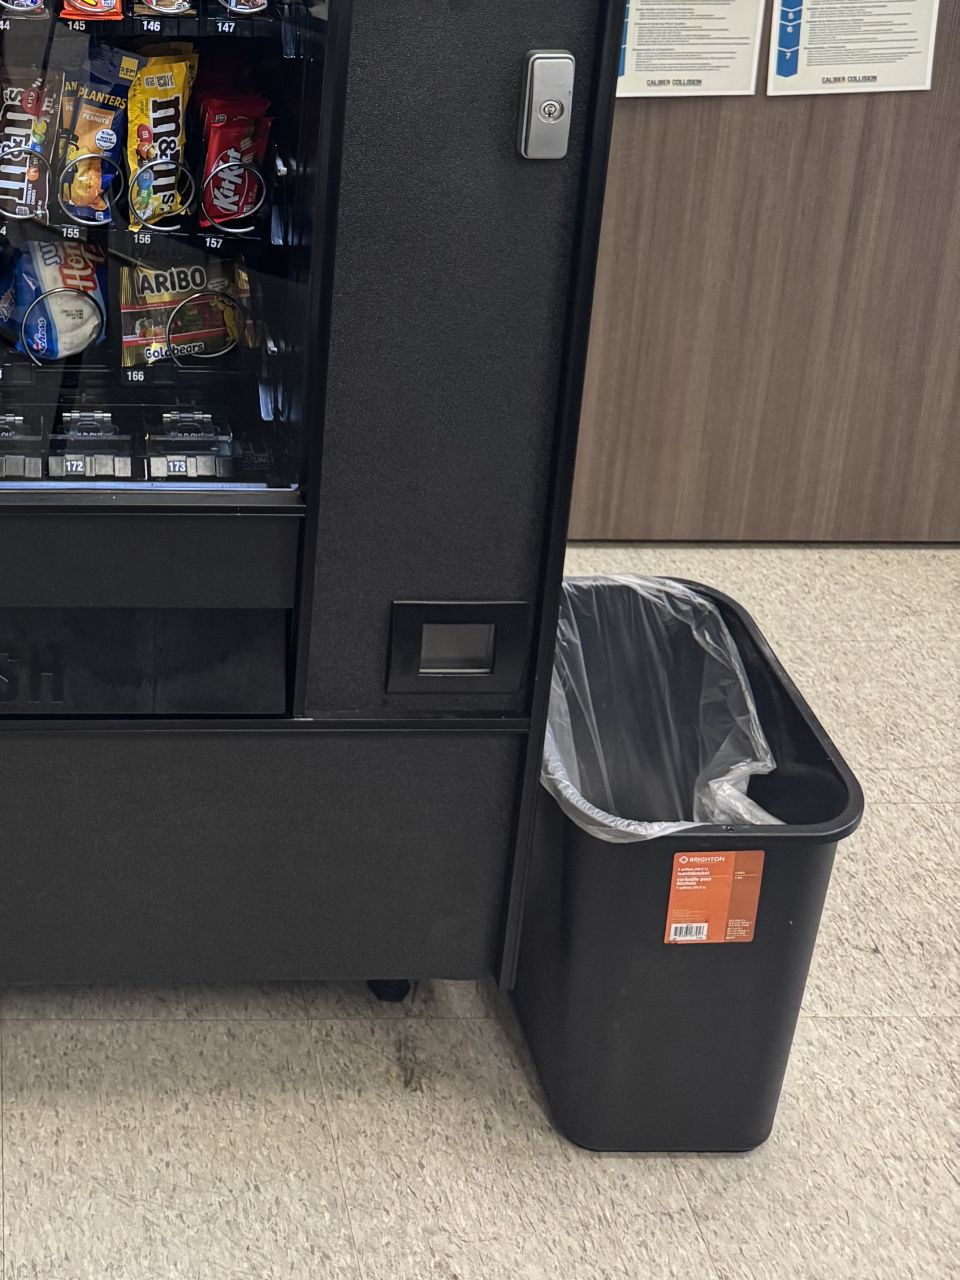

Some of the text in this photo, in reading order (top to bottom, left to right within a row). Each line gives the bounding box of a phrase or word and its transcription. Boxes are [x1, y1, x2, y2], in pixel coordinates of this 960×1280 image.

[68, 21, 86, 30] 145
[142, 21, 161, 31] 146
[217, 22, 235, 32] 147
[77, 88, 128, 109] PLANTERS
[82, 113, 110, 125] PEANUTS
[62, 228, 79, 238] 155
[134, 234, 151, 244] 156
[205, 237, 223, 248] 157
[144, 341, 204, 359] Goldbears
[126, 371, 144, 381] 166
[66, 461, 83, 472] 172
[168, 461, 186, 472] 173
